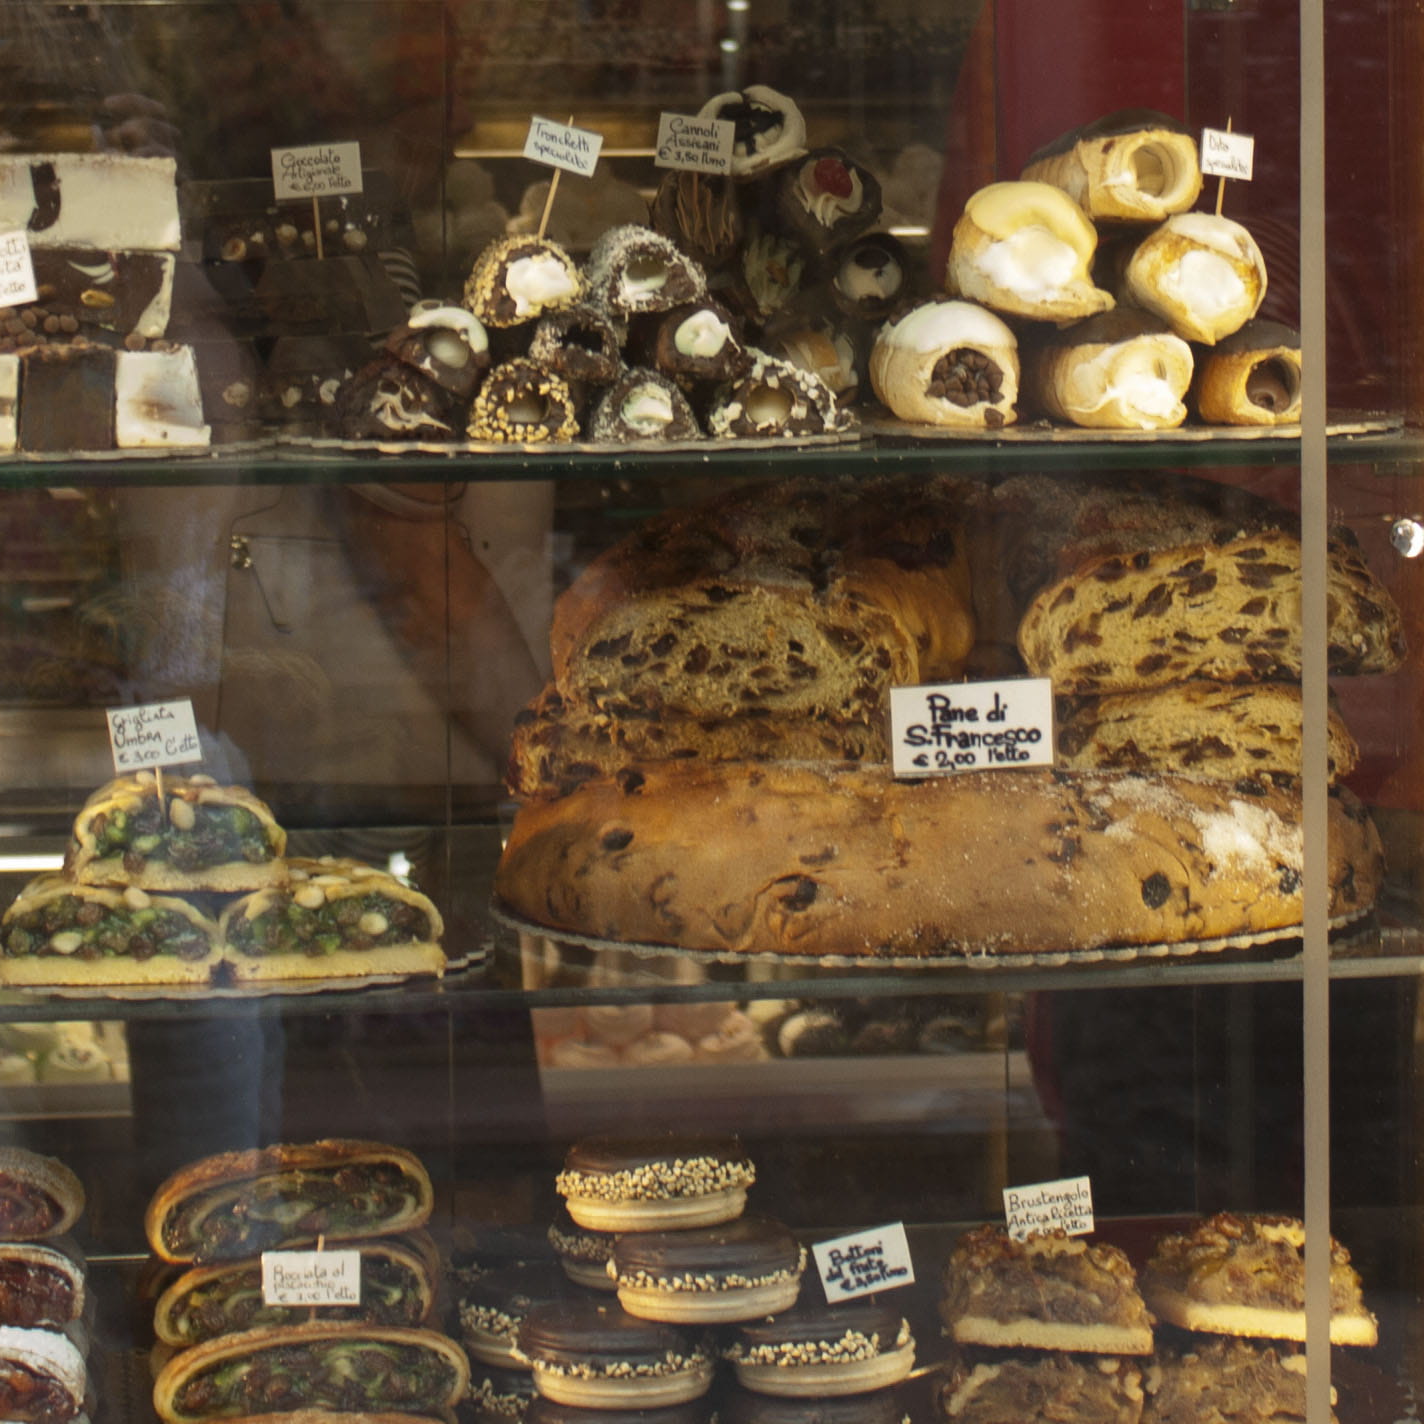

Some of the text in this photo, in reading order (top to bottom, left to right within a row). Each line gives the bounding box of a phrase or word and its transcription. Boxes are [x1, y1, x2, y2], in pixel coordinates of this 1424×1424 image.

[669, 117, 720, 139] Cannoli
[658, 145, 672, 161] €
[926, 691, 1009, 723] Pane di
[912, 746, 1031, 771] € 2,00 l'etto
[1008, 1183, 1089, 1213] Brustengolo
[1008, 1211, 1050, 1229] Antica
